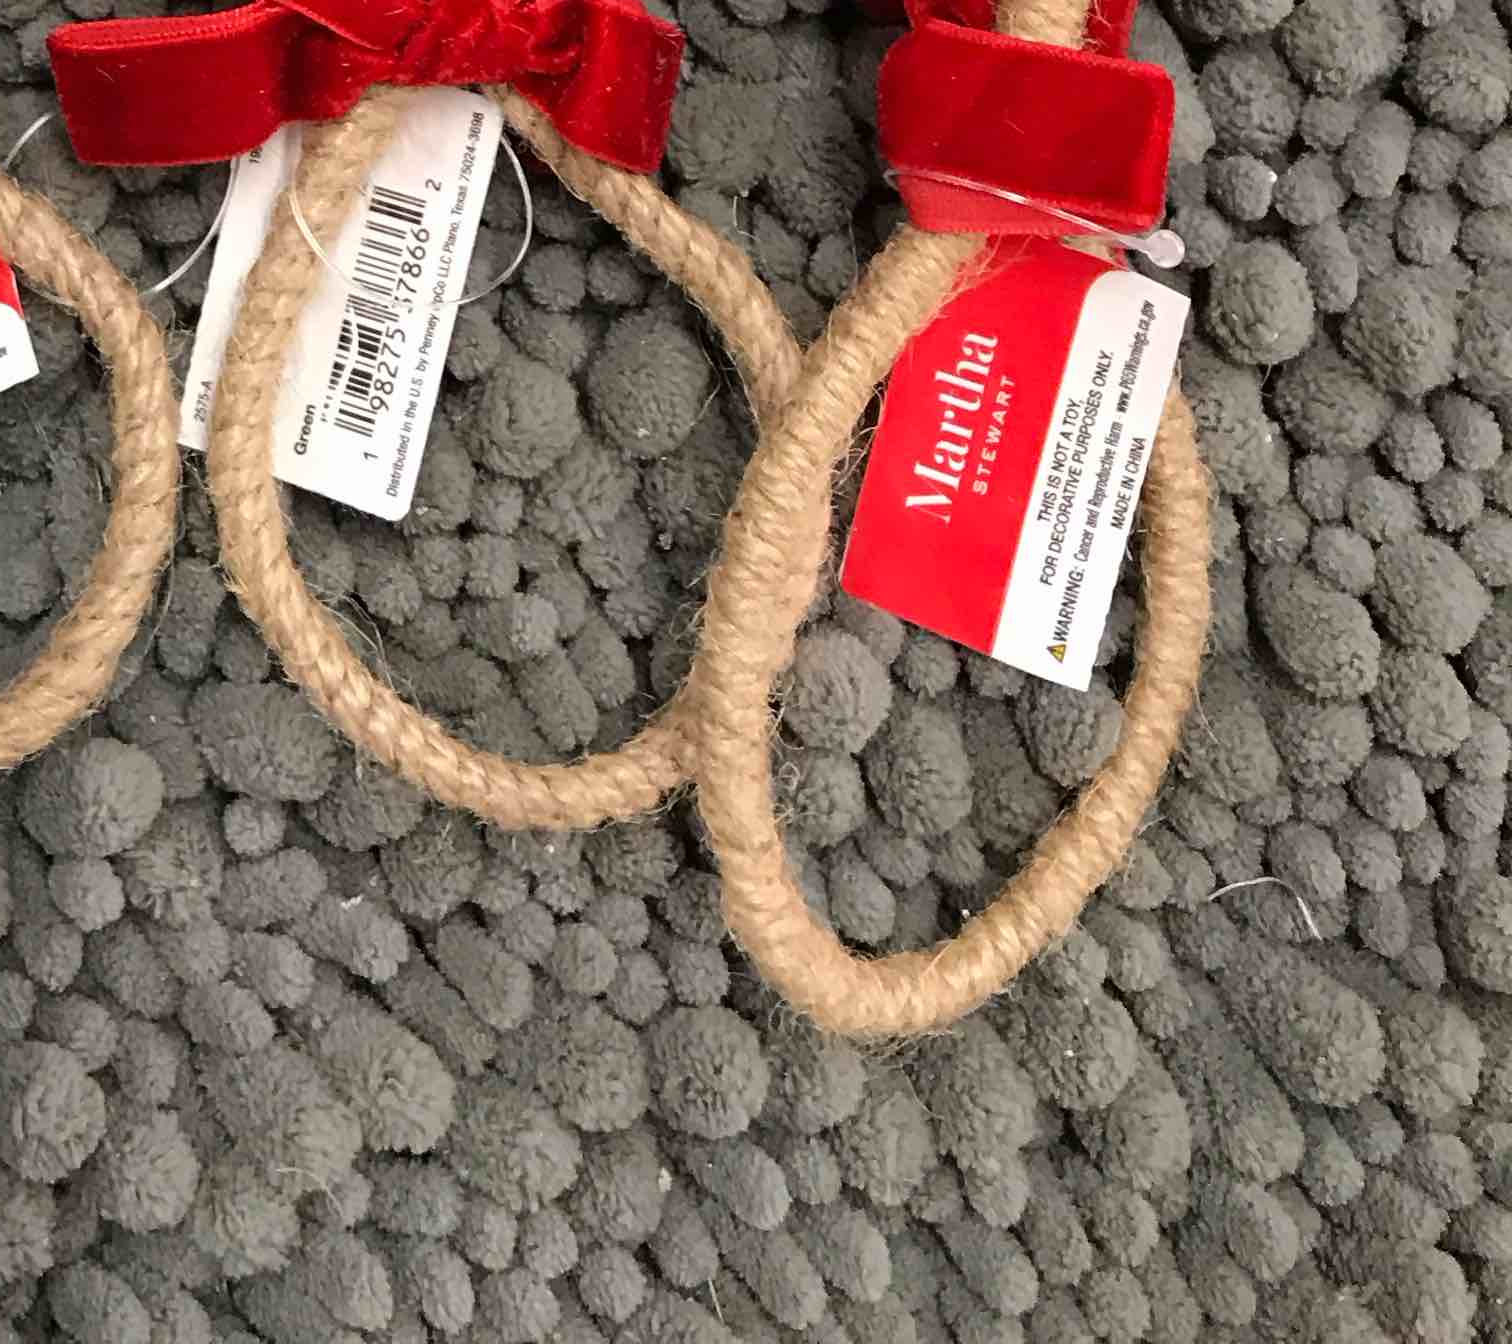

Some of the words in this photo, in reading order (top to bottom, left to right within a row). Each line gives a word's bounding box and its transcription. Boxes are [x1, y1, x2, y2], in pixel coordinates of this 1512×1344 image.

[369, 326, 406, 411] 98275
[385, 435, 410, 497] Distributed
[419, 314, 440, 355] Penney
[430, 280, 447, 311] pCo
[1092, 350, 1113, 387] ONLY.
[293, 404, 316, 455] Green
[903, 331, 997, 524] Martha
[972, 375, 1015, 495] STEWART
[1071, 390, 1103, 464] PURPOSES
[1037, 491, 1057, 521] THIS
[1051, 442, 1069, 472] NOT
[1048, 466, 1082, 553] DECORATIVE
[1110, 492, 1131, 529] MADE
[1125, 437, 1146, 474] CHINA
[1040, 556, 1058, 585] FOR
[1053, 567, 1085, 642] WARNING:
[1074, 529, 1094, 562] Cancer
[1088, 448, 1117, 508] Reproductive
[1104, 421, 1123, 447] Harm
